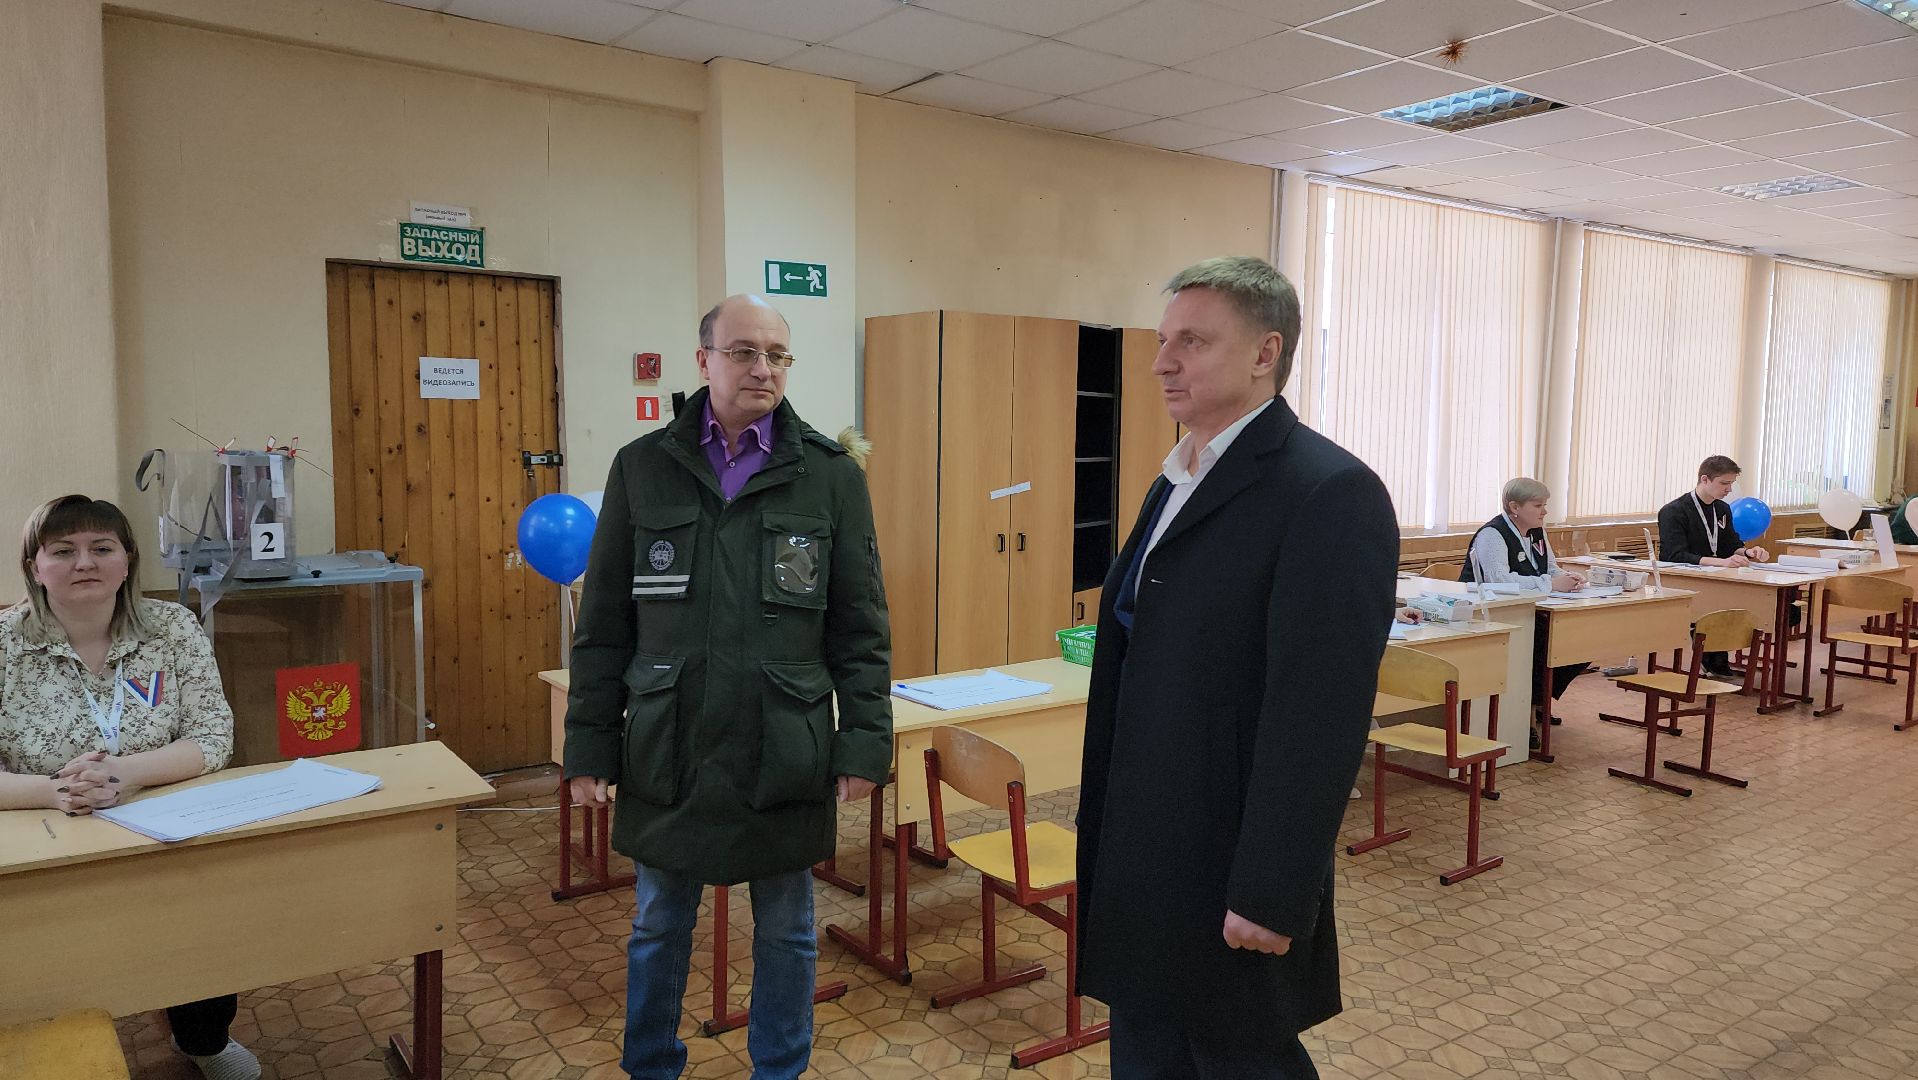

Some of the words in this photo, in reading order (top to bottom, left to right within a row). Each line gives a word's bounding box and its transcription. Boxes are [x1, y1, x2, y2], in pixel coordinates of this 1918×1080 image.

[403, 226, 480, 245] ЗАПАСНЫЙ
[402, 238, 481, 264] ВЫХОД
[422, 379, 475, 387] ВИДЕОЗАПИСЬ
[260, 531, 275, 553] 2
